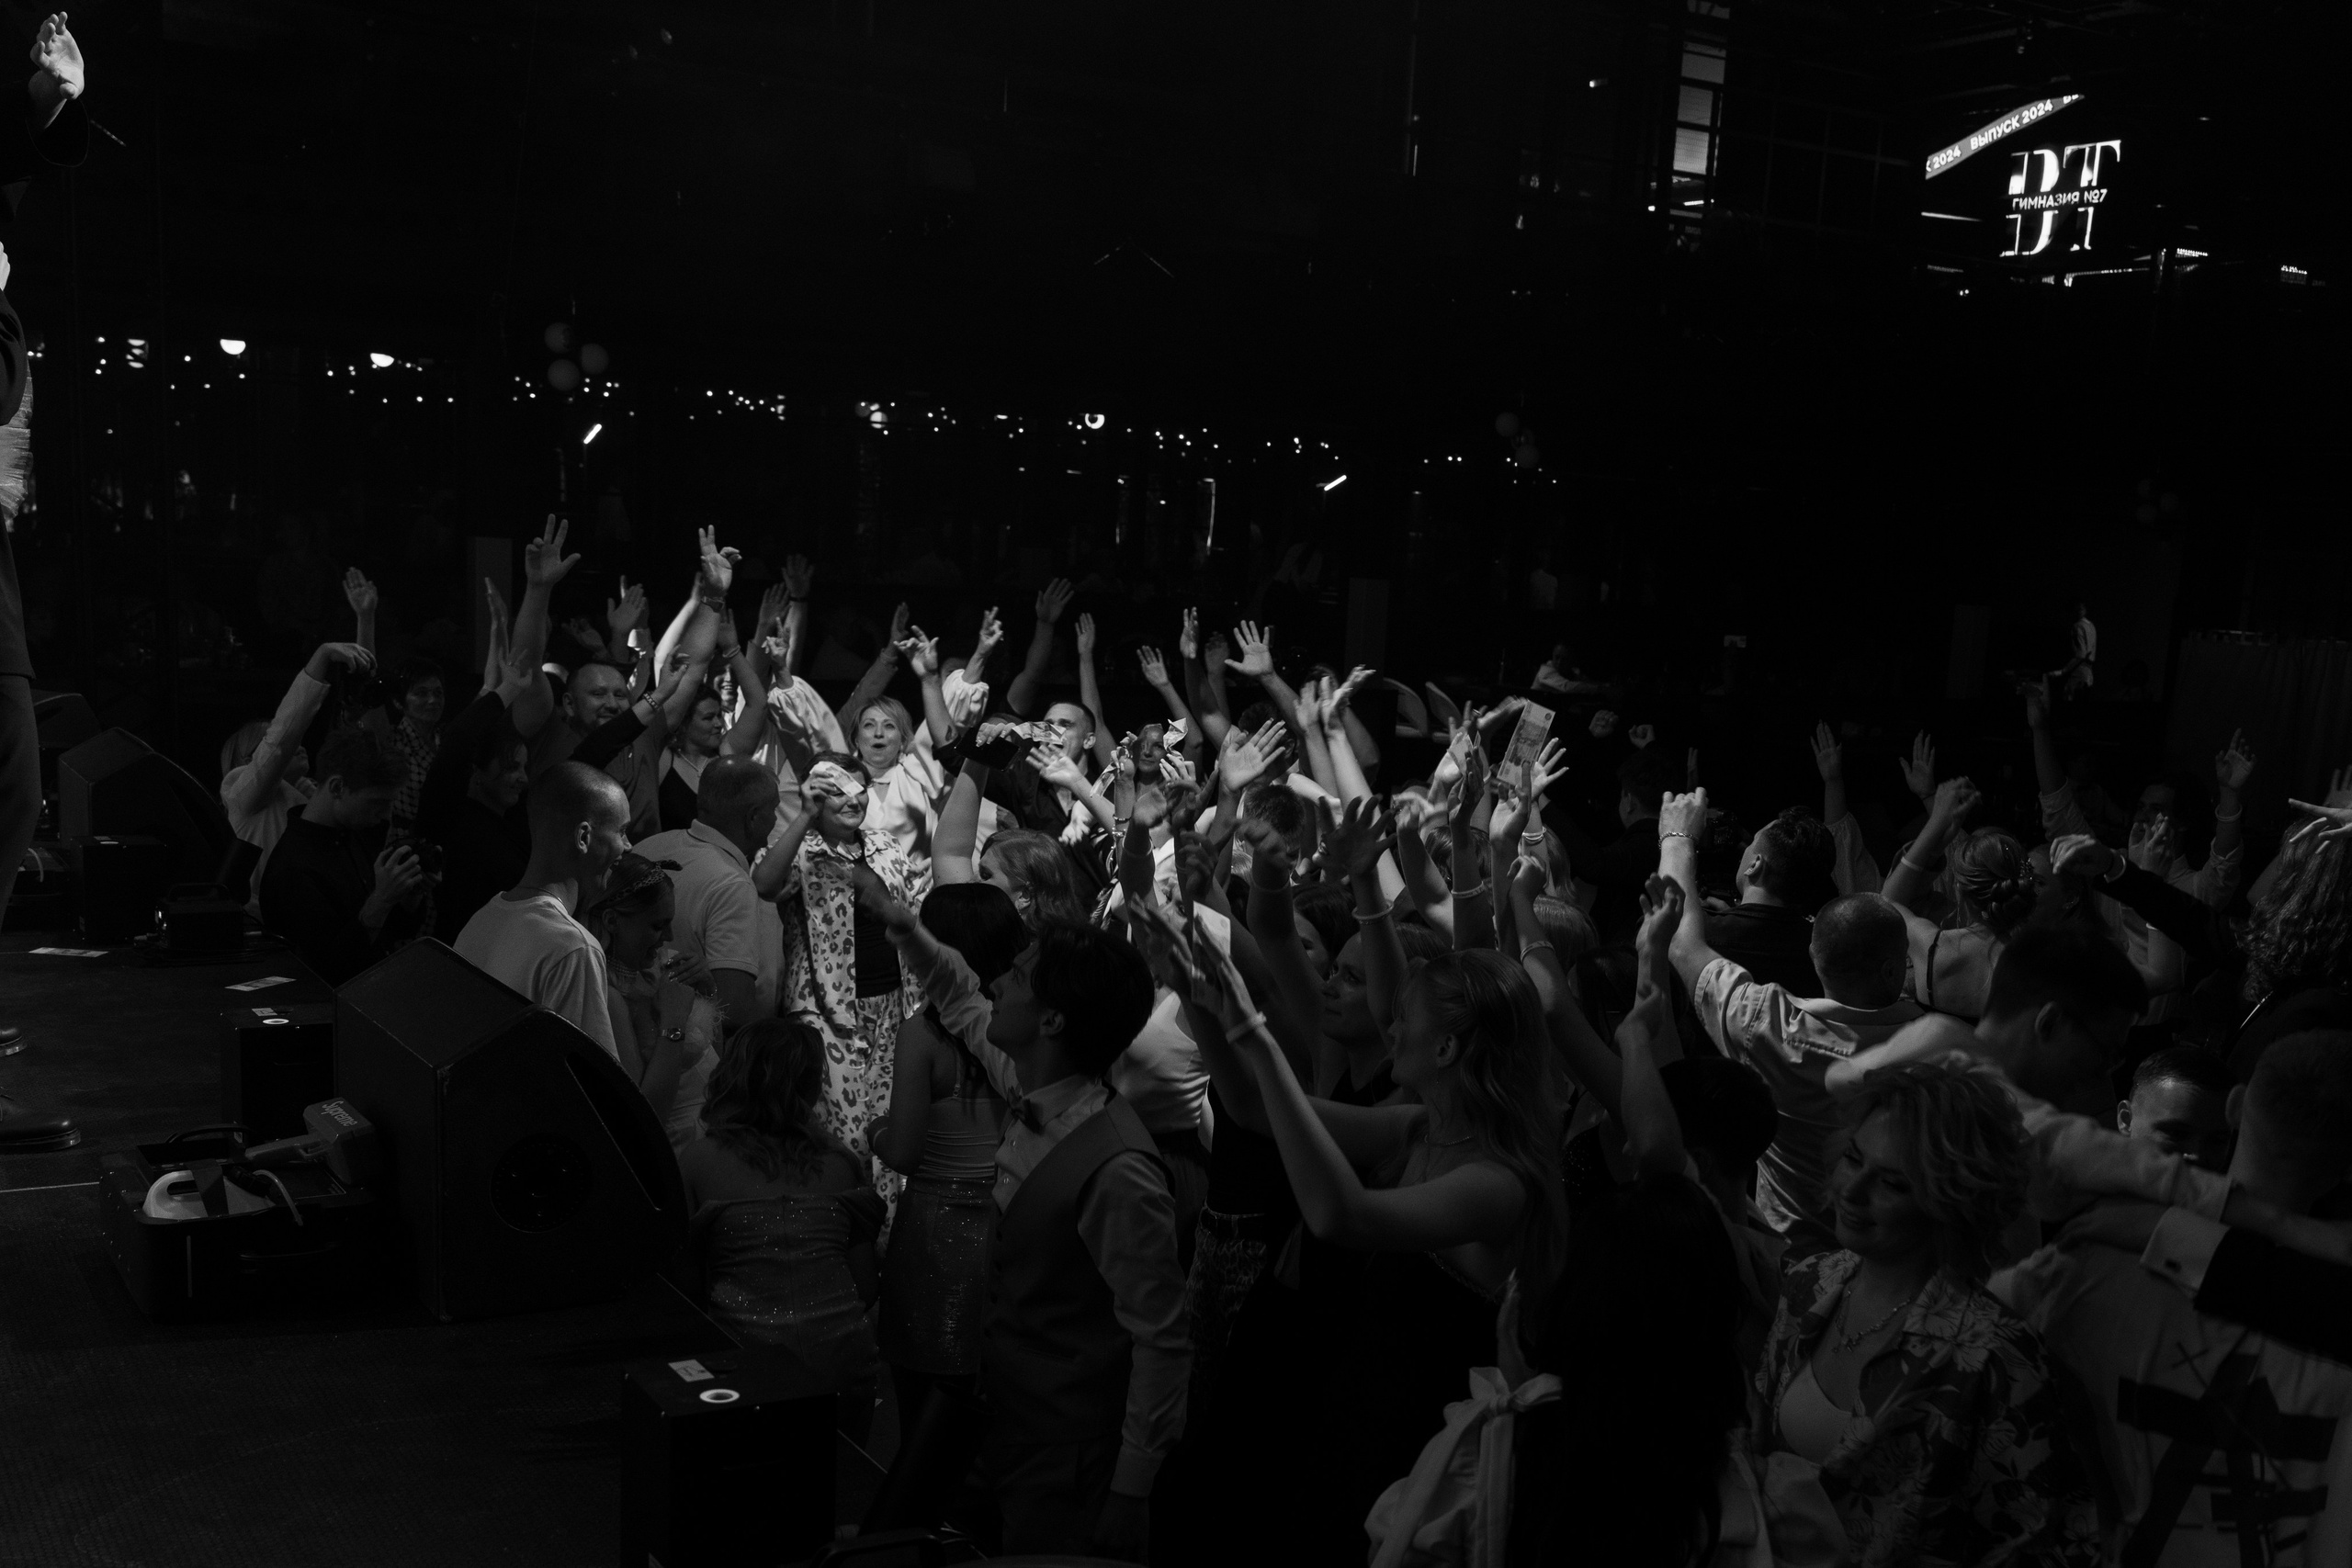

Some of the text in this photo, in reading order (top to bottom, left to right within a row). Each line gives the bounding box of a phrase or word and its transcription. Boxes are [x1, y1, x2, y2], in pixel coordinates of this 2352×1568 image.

[1932, 145, 1962, 169] 2024
[1970, 114, 2020, 151] ВЫПУСК
[2021, 99, 2053, 124] 2024
[2012, 191, 2080, 210] ГИМНАЗИЯ
[321, 1100, 357, 1127] Supreme
